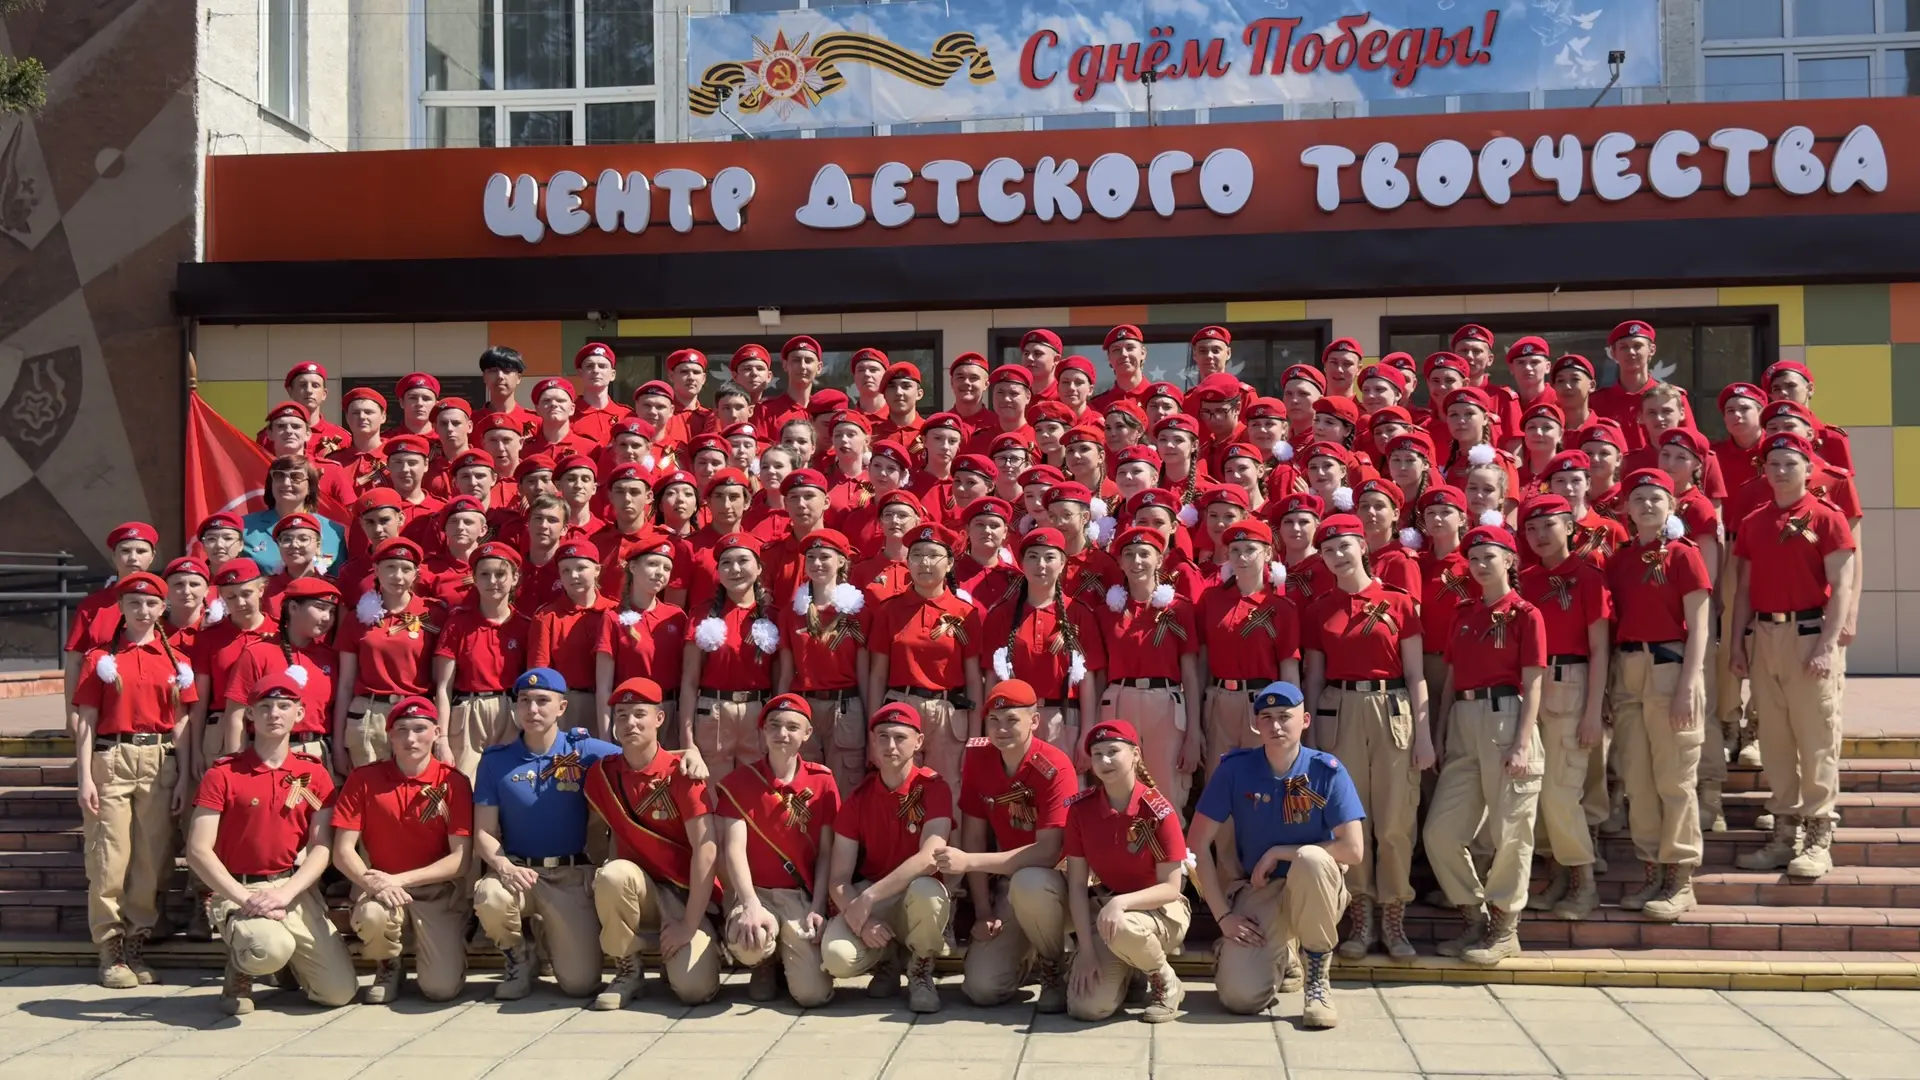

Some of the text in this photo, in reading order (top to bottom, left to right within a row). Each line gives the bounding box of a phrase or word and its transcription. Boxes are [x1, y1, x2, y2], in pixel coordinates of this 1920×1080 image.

[1019, 9, 1499, 102] С днём Победы!
[483, 124, 1888, 244] ЦЕНТР ДЕТСКОГО ТВОРЧЕСТВА
